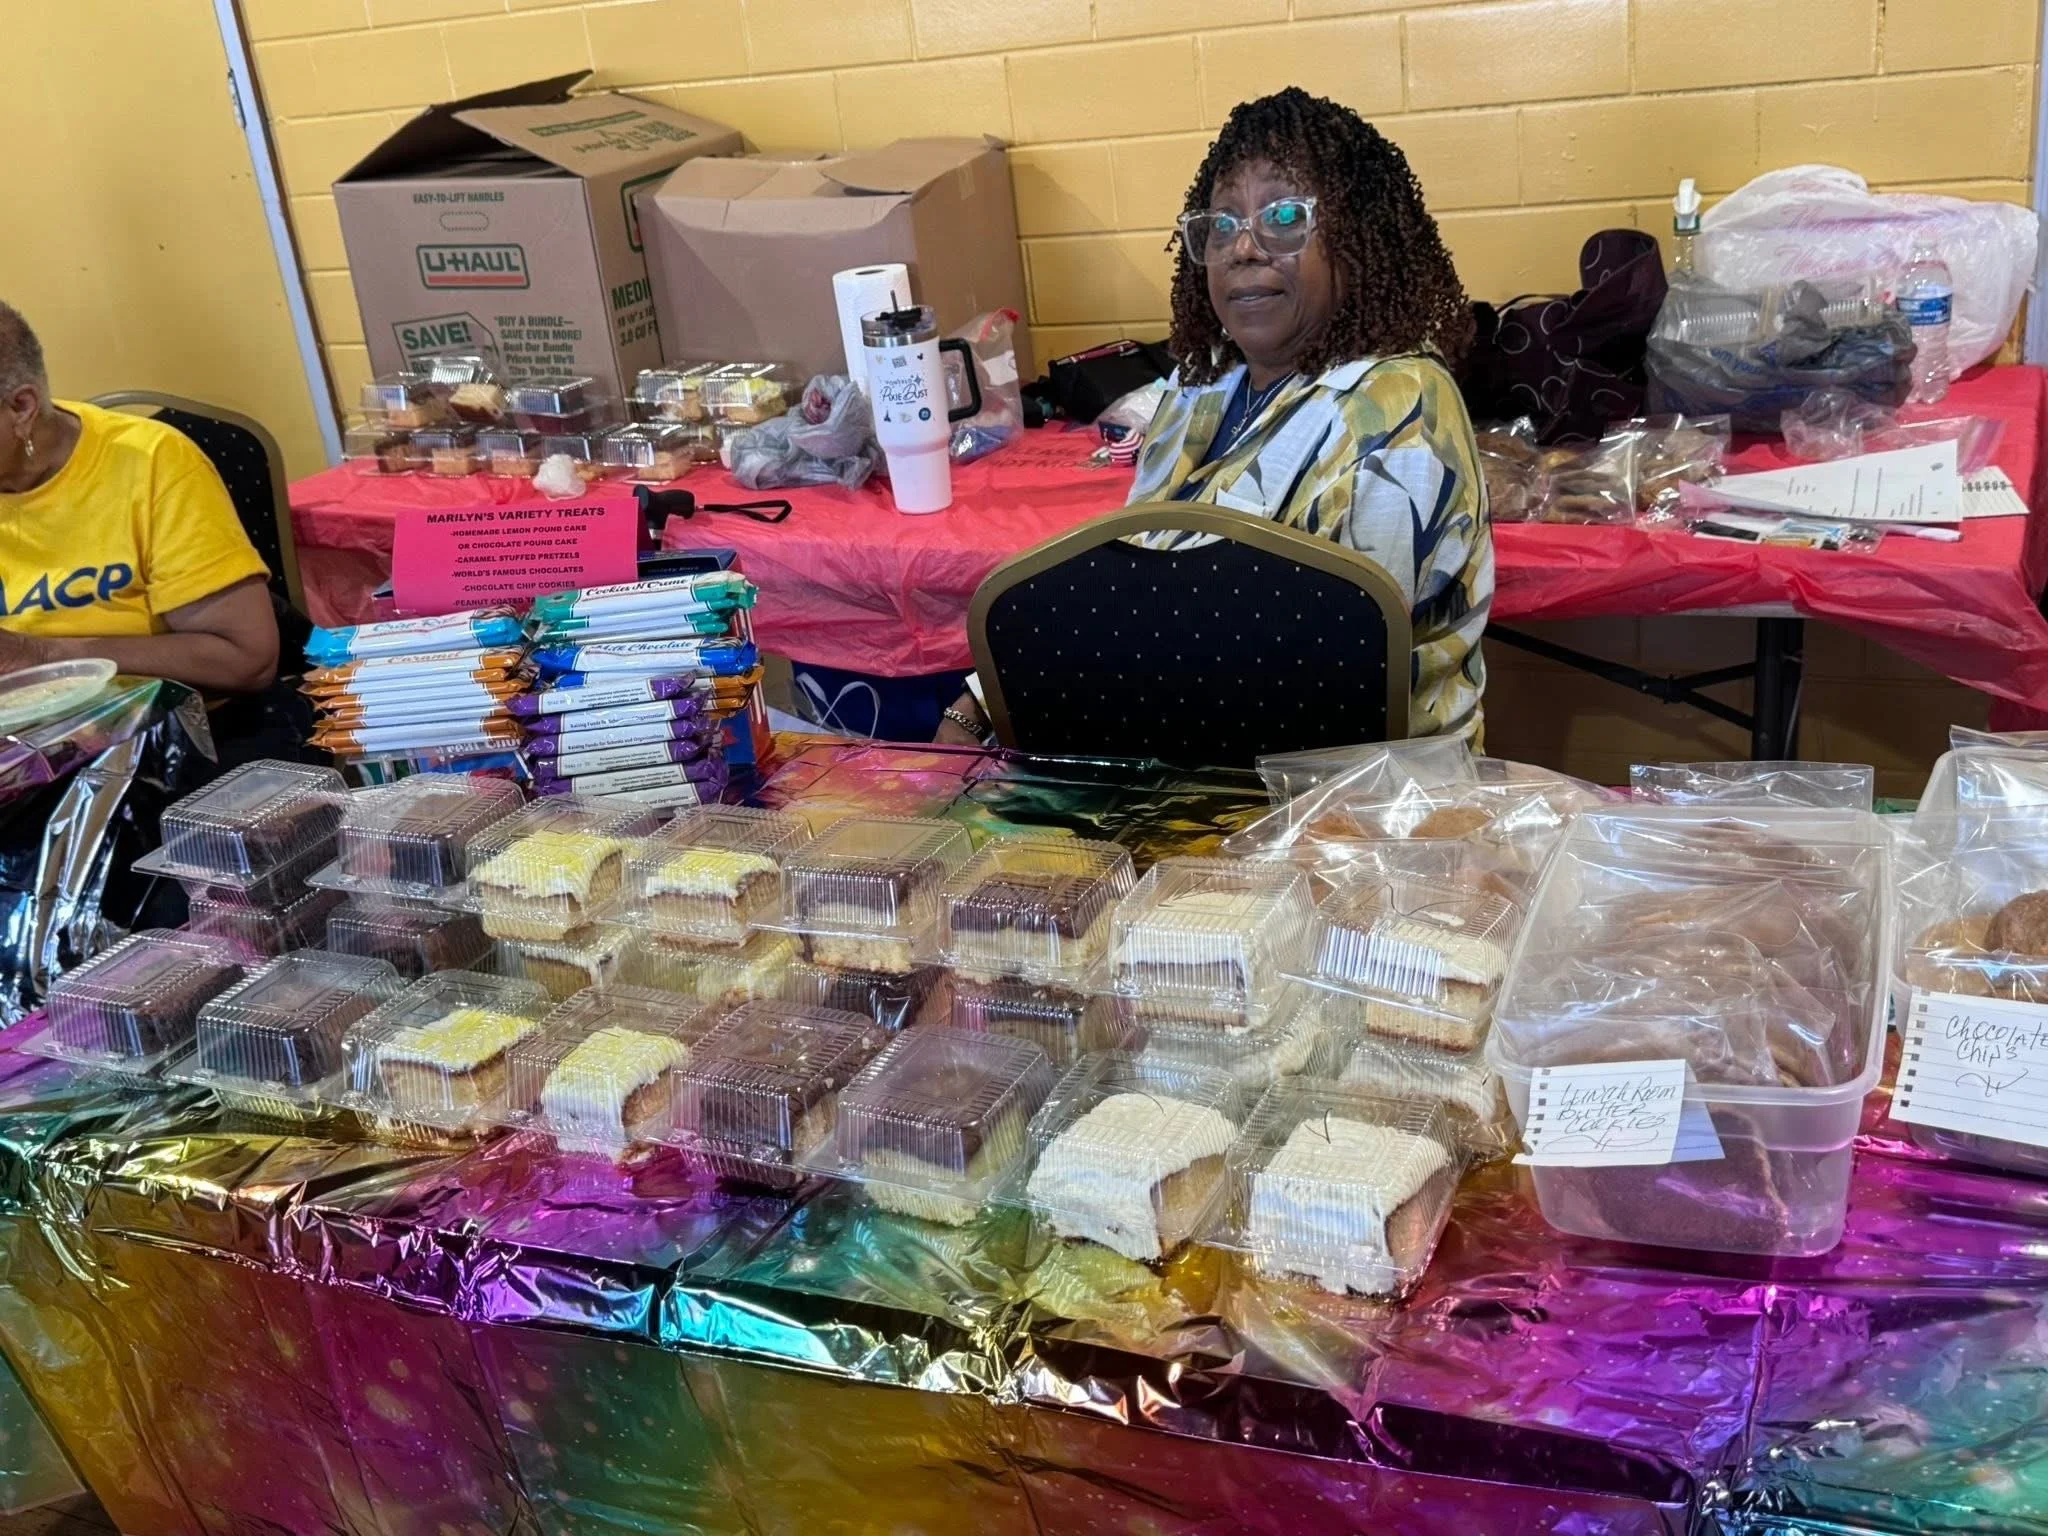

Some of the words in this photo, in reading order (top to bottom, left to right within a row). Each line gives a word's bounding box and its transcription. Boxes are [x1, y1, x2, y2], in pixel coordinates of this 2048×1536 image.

[413, 192, 466, 204] EASY-TO-LIFT
[468, 191, 504, 202] HANDLES
[424, 251, 521, 272] U-HAUL
[518, 315, 525, 327] A
[402, 321, 472, 351] SAVE!
[500, 329, 525, 341] SAVE
[526, 329, 549, 340] EVEN
[551, 329, 582, 341] MORE!
[543, 342, 573, 352] Bundle
[506, 354, 532, 365] Prices
[535, 354, 551, 364] and
[427, 512, 495, 524] MARILYN'S
[498, 509, 553, 520] VARIETY
[556, 507, 605, 518] TREATS
[502, 527, 531, 535] LEMON
[533, 525, 562, 534] POUND
[564, 524, 587, 532] CAKE
[471, 540, 522, 549] CHOCOLATE
[523, 539, 552, 547] POUND
[554, 537, 578, 546] CAKE
[499, 553, 536, 562] STUFFED
[538, 551, 580, 560] PRETZELS
[492, 567, 527, 577] FAMOUS
[529, 565, 584, 575] CHOCOLATES
[516, 582, 536, 590] CHIP
[538, 581, 576, 589] COOKIES
[586, 585, 630, 597] Cookies
[628, 641, 693, 652] Chocolate
[388, 652, 460, 663] Caramel
[568, 743, 585, 751] Raising
[634, 734, 665, 744] Organizations
